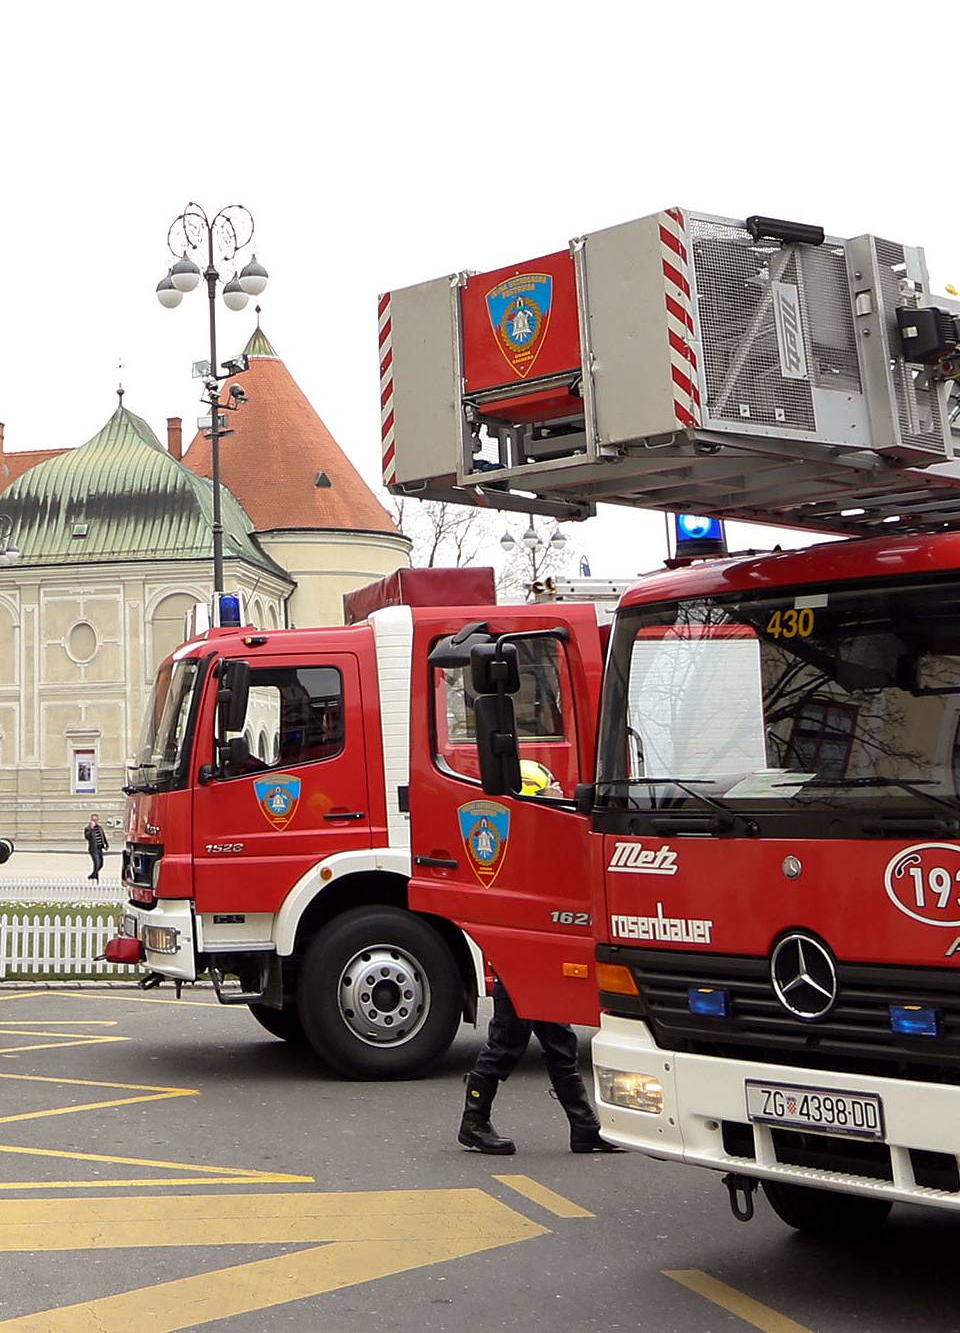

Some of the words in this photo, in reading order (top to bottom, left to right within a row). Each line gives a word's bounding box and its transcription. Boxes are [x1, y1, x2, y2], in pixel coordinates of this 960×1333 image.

[766, 608, 815, 639] 430
[608, 842, 679, 875] Metz
[909, 867, 960, 908] 19
[550, 911, 593, 926] 162
[610, 902, 713, 944] rosenbauer
[761, 1089, 786, 1117] ZG
